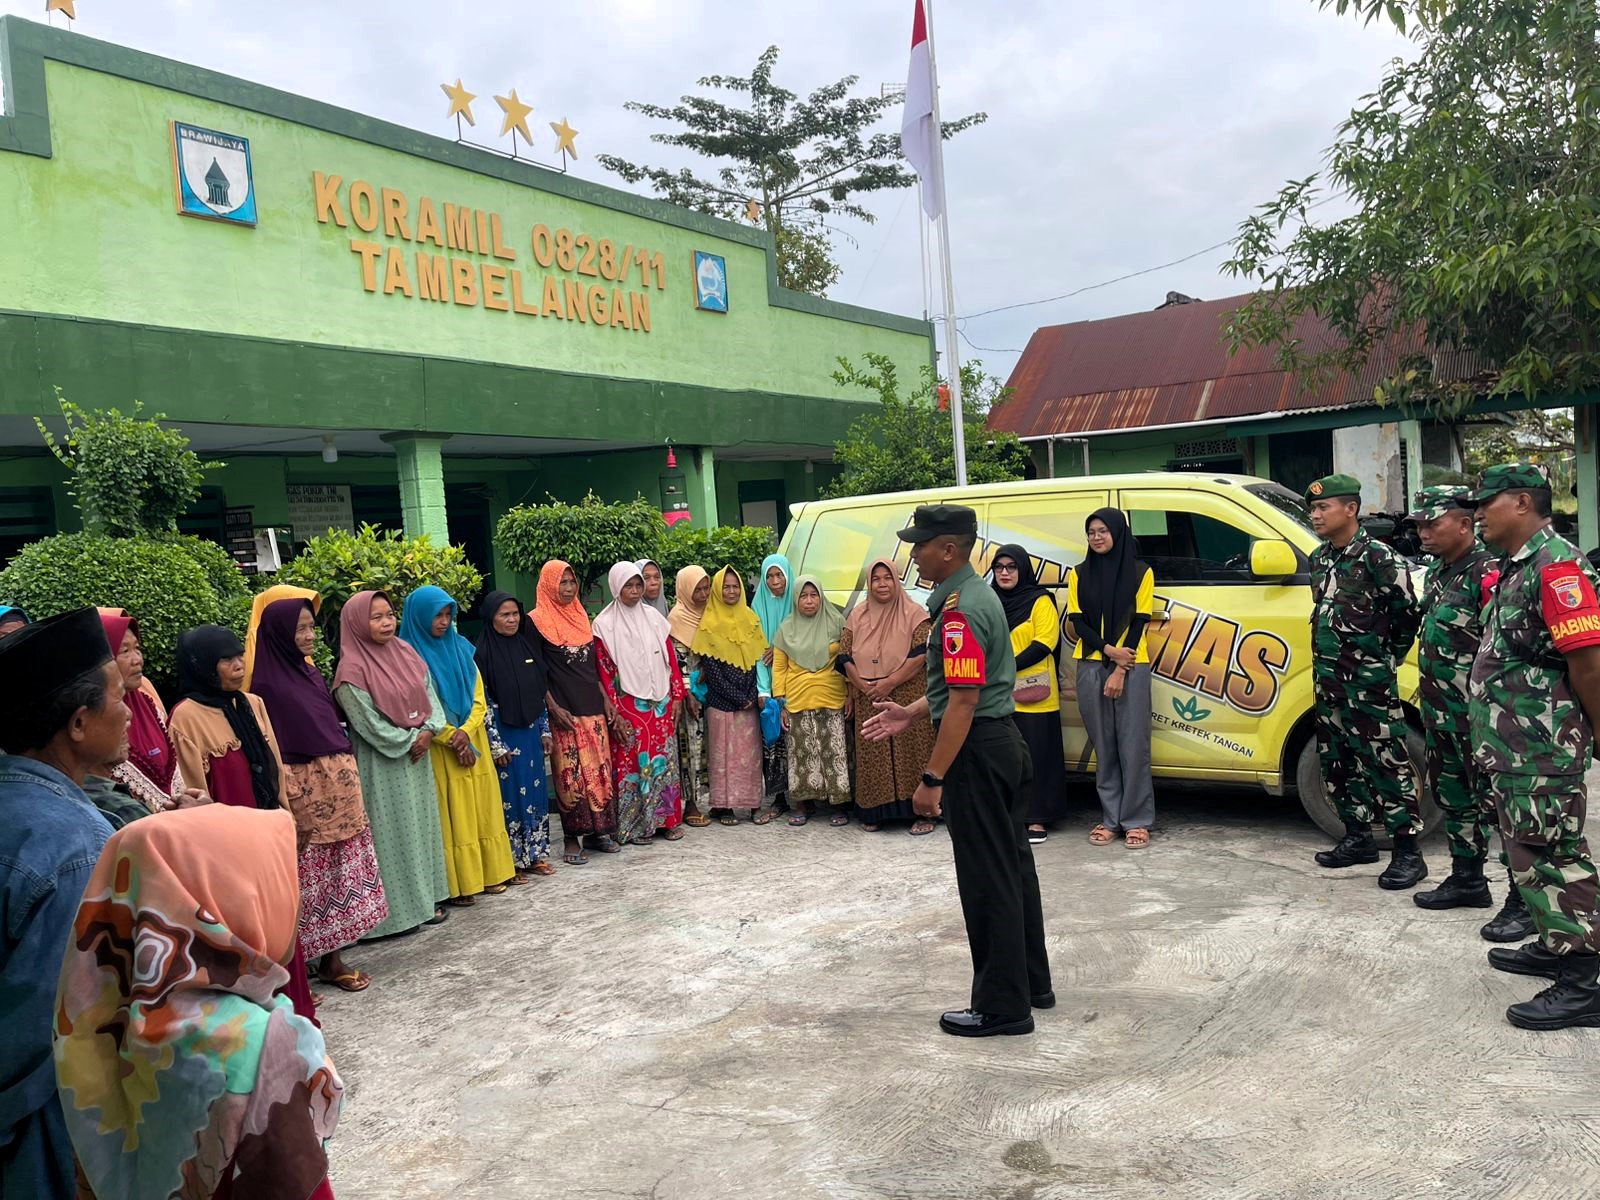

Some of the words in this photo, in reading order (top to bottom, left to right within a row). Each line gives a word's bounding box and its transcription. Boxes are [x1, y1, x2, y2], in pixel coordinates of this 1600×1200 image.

[180, 127, 245, 151] BRAWIJAYA
[313, 170, 516, 261] KORAMIL
[531, 223, 665, 290] 0828/11
[350, 239, 651, 332] TAMBELANGAN
[1171, 719, 1211, 740] KRETEK
[1213, 734, 1254, 758] TANGAN
